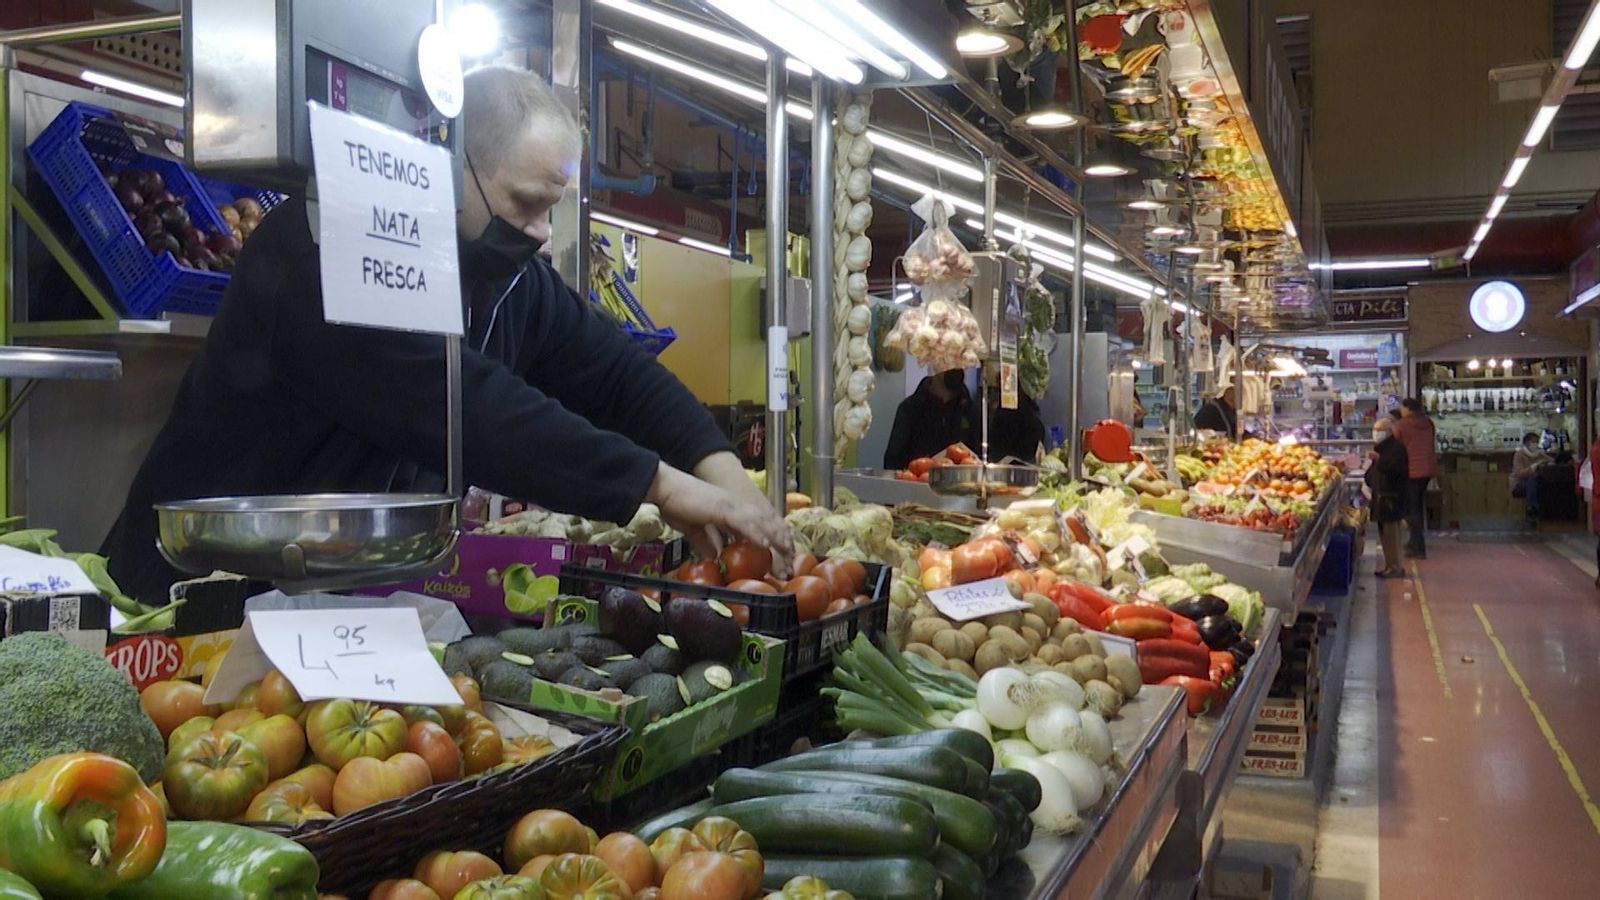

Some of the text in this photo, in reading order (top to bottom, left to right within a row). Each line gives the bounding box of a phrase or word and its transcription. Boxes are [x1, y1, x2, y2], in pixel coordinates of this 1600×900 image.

[343, 140, 430, 190] TENEMOS
[373, 205, 420, 240] NATA
[362, 256, 427, 292] FRESCA
[333, 625, 368, 650] 95
[1259, 707, 1299, 721] RES-LUZ
